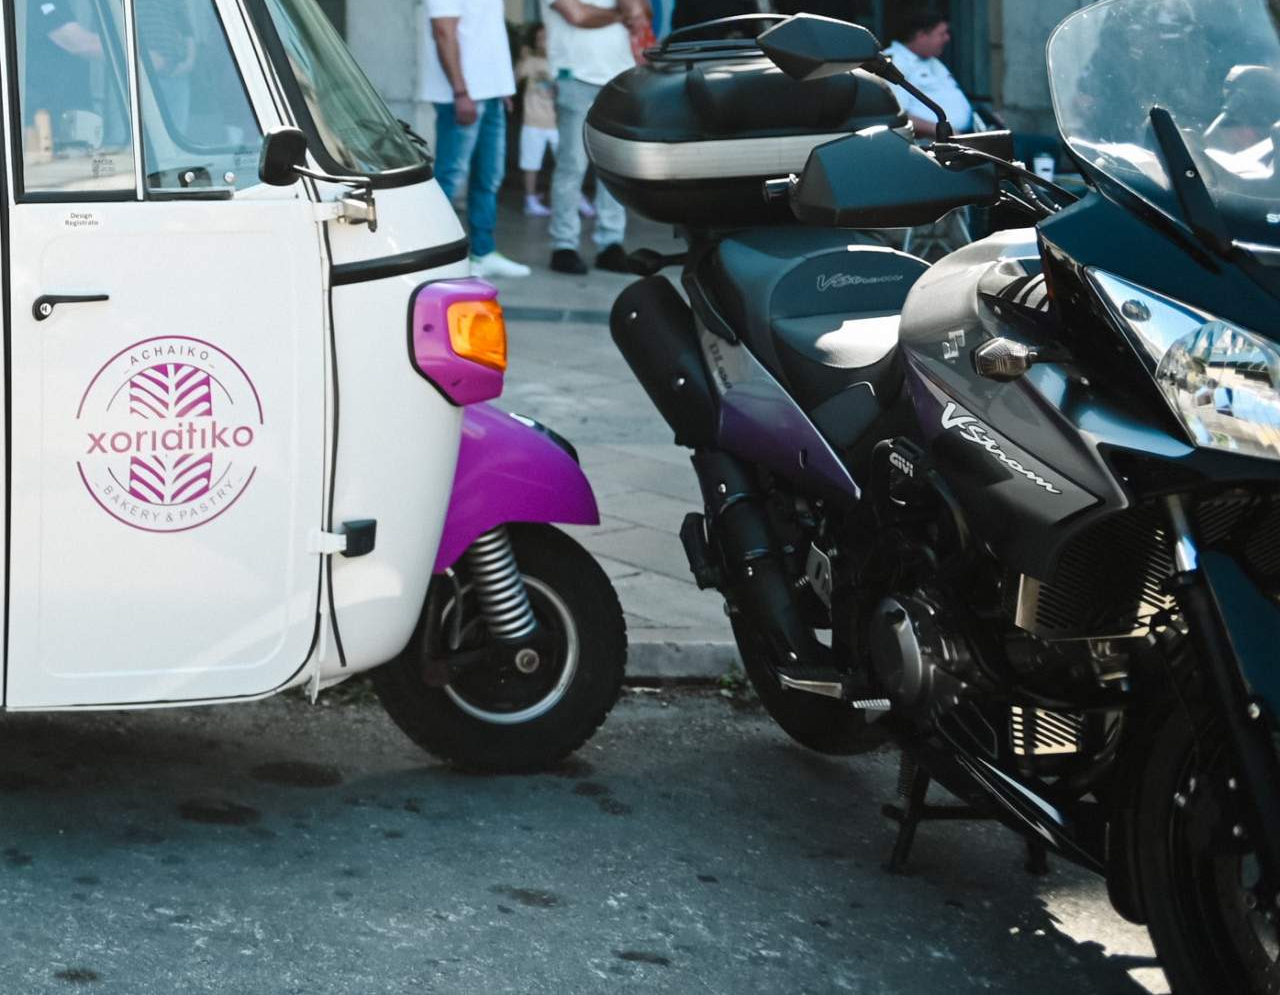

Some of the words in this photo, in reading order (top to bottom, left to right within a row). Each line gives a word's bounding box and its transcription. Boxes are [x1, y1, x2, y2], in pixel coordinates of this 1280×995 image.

[129, 345, 209, 366] ACHAIKO
[104, 485, 160, 522] BAKERY
[179, 480, 234, 522] PASTRY
